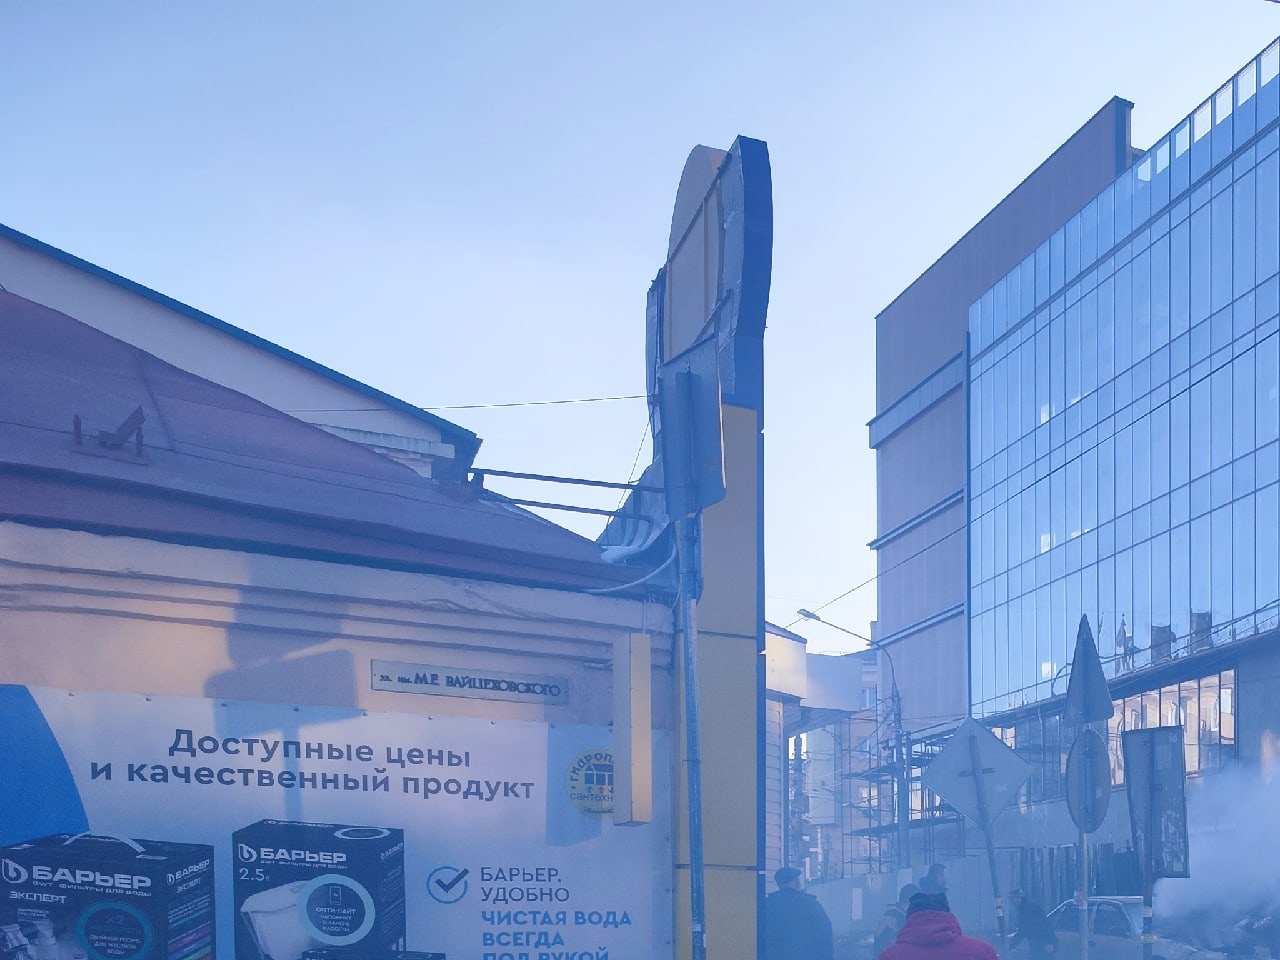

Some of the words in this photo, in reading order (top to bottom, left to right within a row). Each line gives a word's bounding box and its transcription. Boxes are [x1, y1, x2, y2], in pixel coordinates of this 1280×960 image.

[168, 728, 374, 763] Доступные
[386, 747, 470, 768] цены
[90, 761, 112, 781] и
[128, 762, 389, 793] качественный
[403, 776, 535, 802] продукт
[260, 847, 347, 865] БАРЬЕР
[32, 866, 152, 889] БАРЬЕР
[239, 867, 265, 882] 2.5
[9, 891, 67, 904] ЭКСПЕРТ
[480, 887, 570, 904] УДОБНО
[481, 910, 567, 926] ЧИСТАЯ
[574, 911, 632, 928] ВОДА
[482, 931, 565, 949] ВСЕГДА
